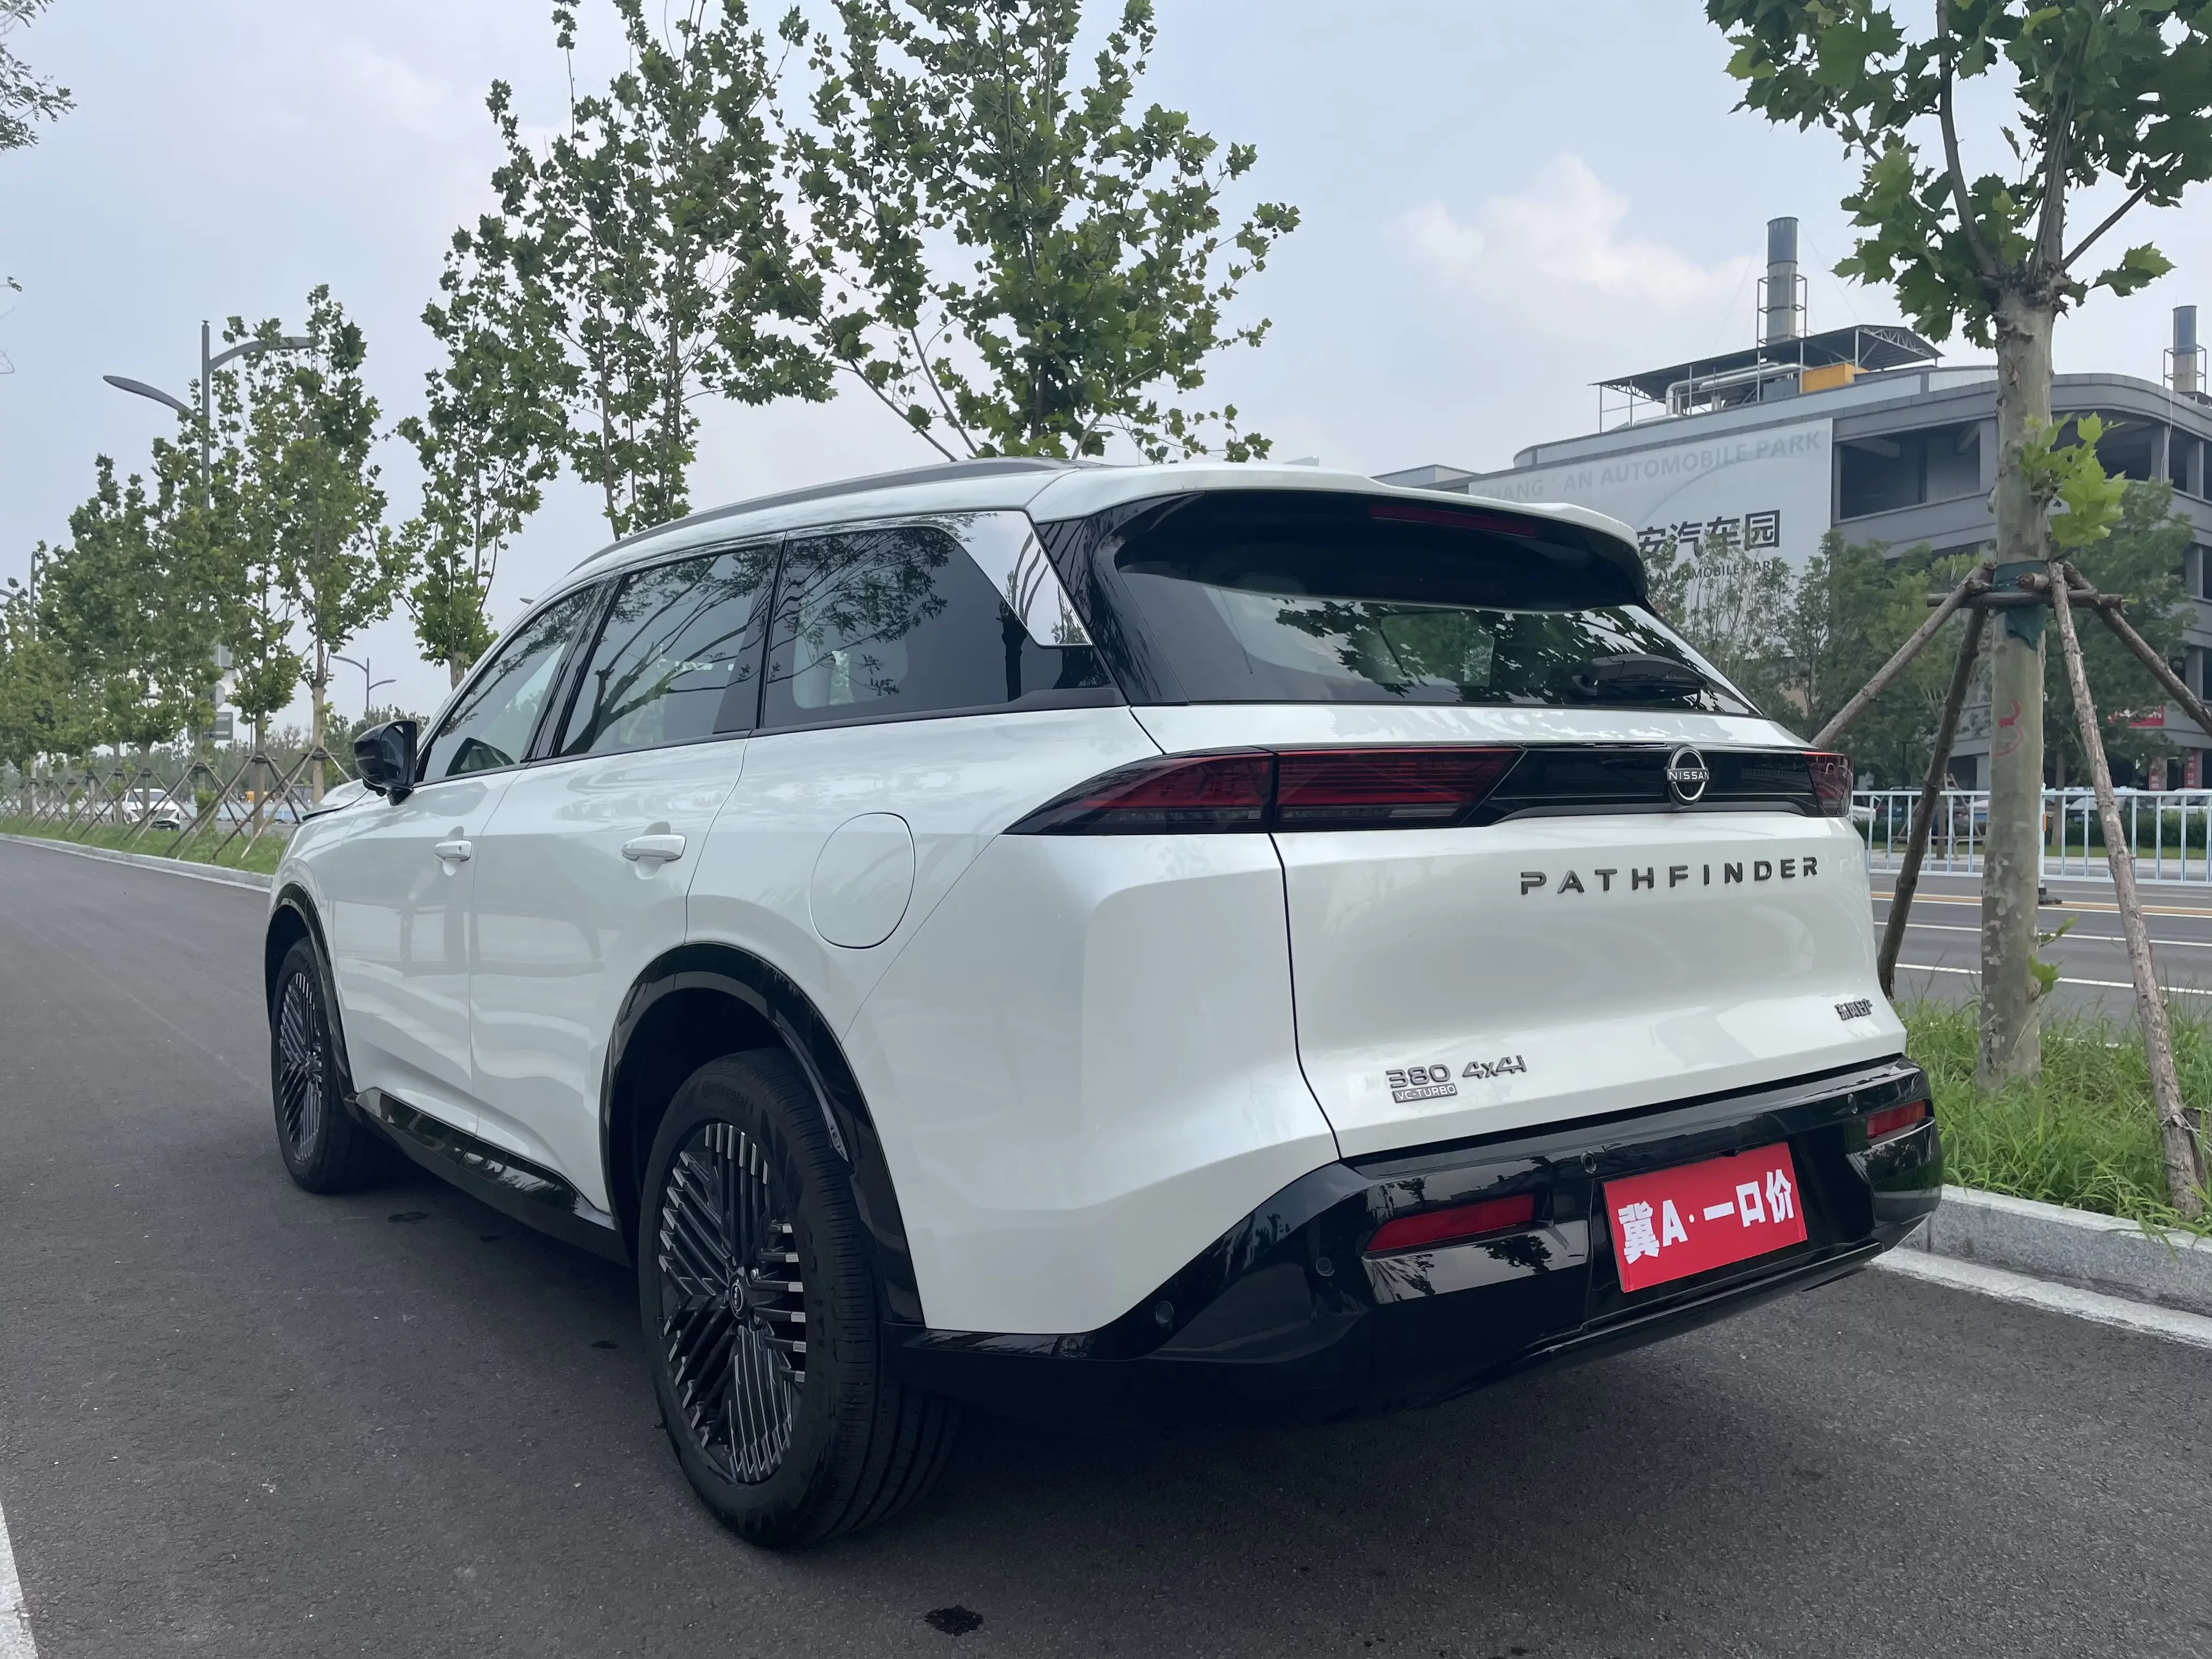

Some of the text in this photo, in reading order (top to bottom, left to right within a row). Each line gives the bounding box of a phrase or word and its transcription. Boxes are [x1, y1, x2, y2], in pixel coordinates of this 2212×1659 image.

[1600, 443, 1747, 486] AUTOMOBILE
[1756, 430, 1821, 459] PARK
[1669, 771, 1709, 780] NISSAN
[1521, 856, 1818, 895] PATHFINDER
[1386, 1064, 1451, 1088] 380
[1396, 1085, 1455, 1101] VC-TURBO
